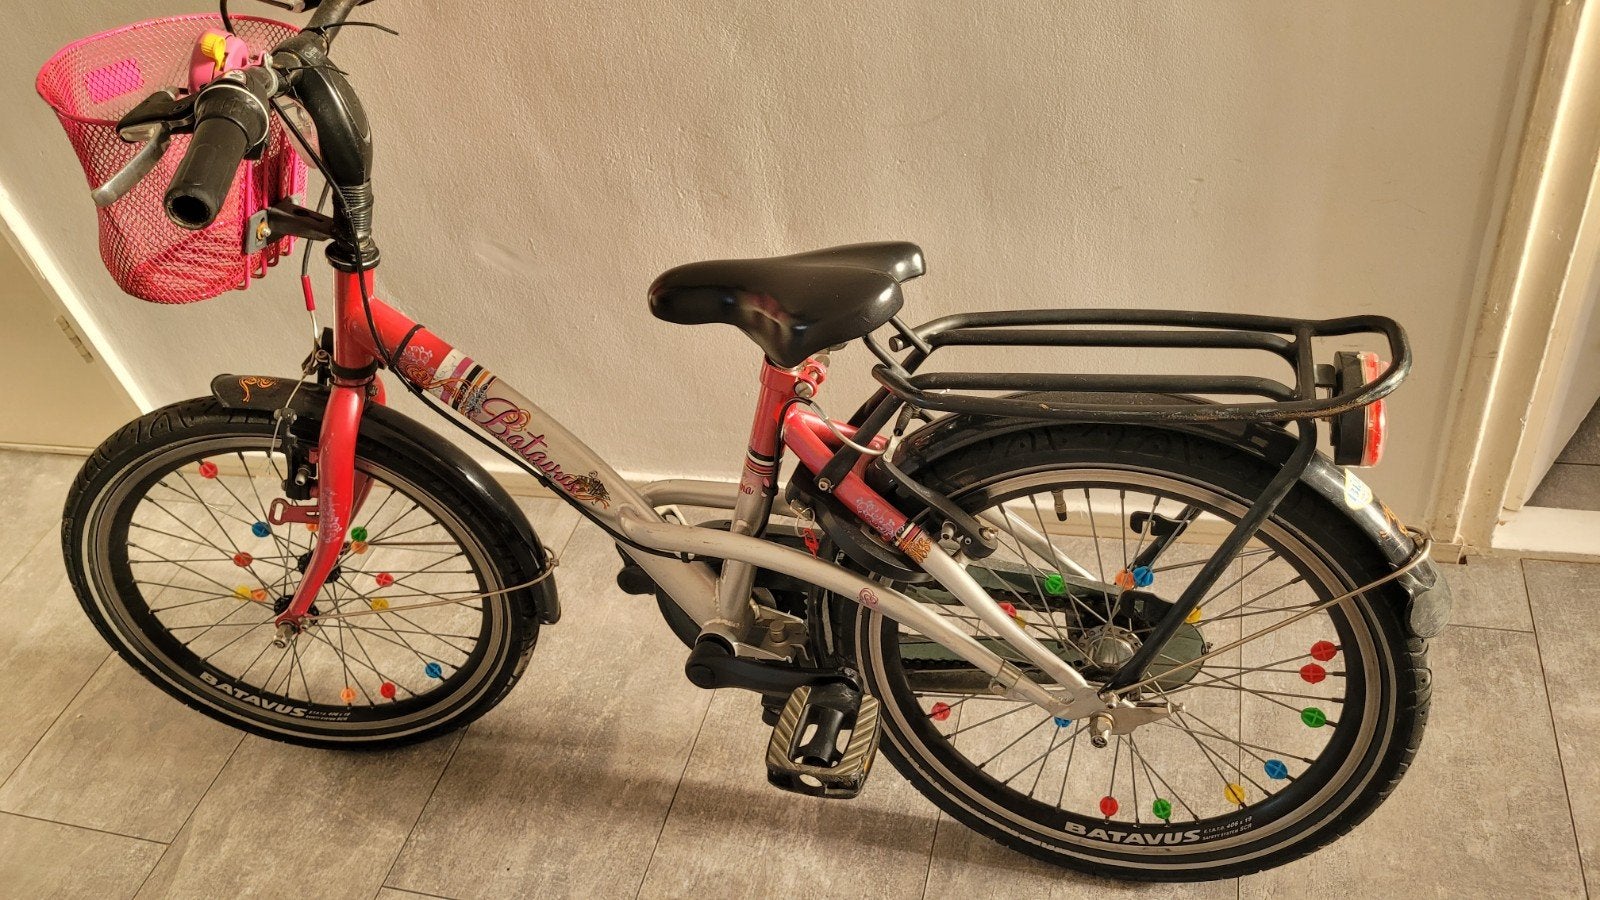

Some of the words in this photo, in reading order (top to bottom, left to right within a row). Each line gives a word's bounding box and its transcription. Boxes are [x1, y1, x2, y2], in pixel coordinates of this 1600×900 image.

[468, 397, 578, 494] Batavus
[200, 671, 308, 717] BATAVUS
[1065, 821, 1200, 845] BATAVUS
